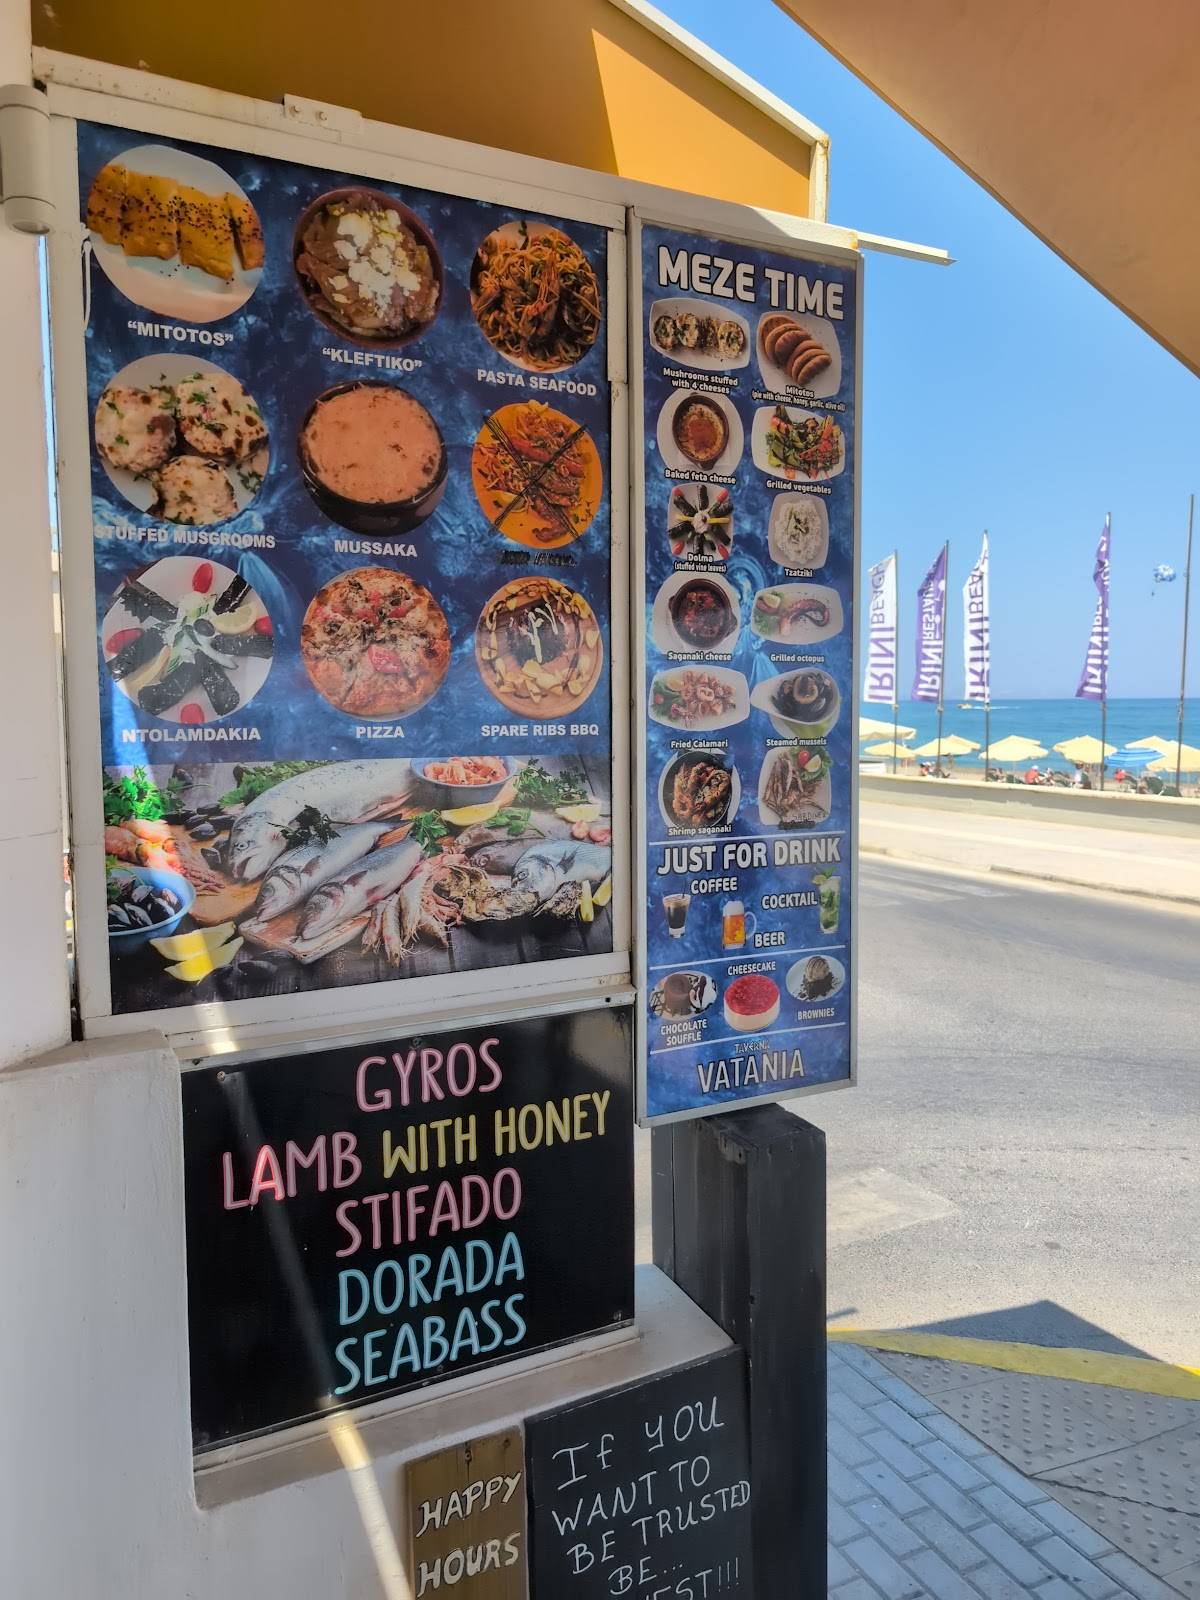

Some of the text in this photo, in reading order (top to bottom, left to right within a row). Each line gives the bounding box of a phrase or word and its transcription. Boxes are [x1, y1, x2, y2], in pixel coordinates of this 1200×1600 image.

[658, 245, 845, 321] MEZE TIME
[477, 368, 597, 397] PASTA SEAFOOD
[663, 367, 739, 387] Mushrooms stuffed
[671, 378, 730, 395] with 4 cheeses
[785, 385, 815, 399] Mitotos
[664, 469, 736, 485] Baked feta cheese
[766, 480, 832, 495] Grilled vegetables
[94, 524, 276, 549] STUFFED MUSGROOMS
[334, 539, 418, 558] MUSSAKA
[687, 552, 714, 563] Dolma
[784, 568, 813, 578] Tzatziki
[668, 651, 732, 662] Saganaki cheese
[770, 653, 825, 664] Grilled octopus
[121, 726, 262, 743] NTOLAMDAKIA
[355, 725, 406, 740] PIZZA
[480, 723, 600, 738] SPARE RIBS BBQ
[670, 740, 729, 749] Fried Calamari
[766, 738, 827, 747] Steamed mussels
[668, 825, 732, 837] Shrimp saganaki
[657, 837, 842, 875] JUST FOR DRINK
[690, 876, 738, 895] COFFEE
[761, 893, 818, 910] COCKTAIL
[753, 931, 786, 949] BEER
[727, 961, 777, 976] CHEESECAKE
[797, 1007, 836, 1022] BROWNIES
[660, 1018, 708, 1037] CHOCOLATE
[666, 1031, 702, 1047] SOUFFLE
[356, 1037, 503, 1113] GYROS
[697, 1049, 805, 1094] VATANIA
[222, 1090, 611, 1210] LAMB WITH HONEY
[335, 1167, 523, 1258] STIFADO
[338, 1231, 526, 1326] DORADA
[334, 1293, 528, 1396] SEABASS
[551, 1455, 711, 1536] WANT TO
[415, 1472, 523, 1538] HAPPY
[567, 1480, 751, 1575] BE TRUSTED
[416, 1532, 522, 1599] HOURS
